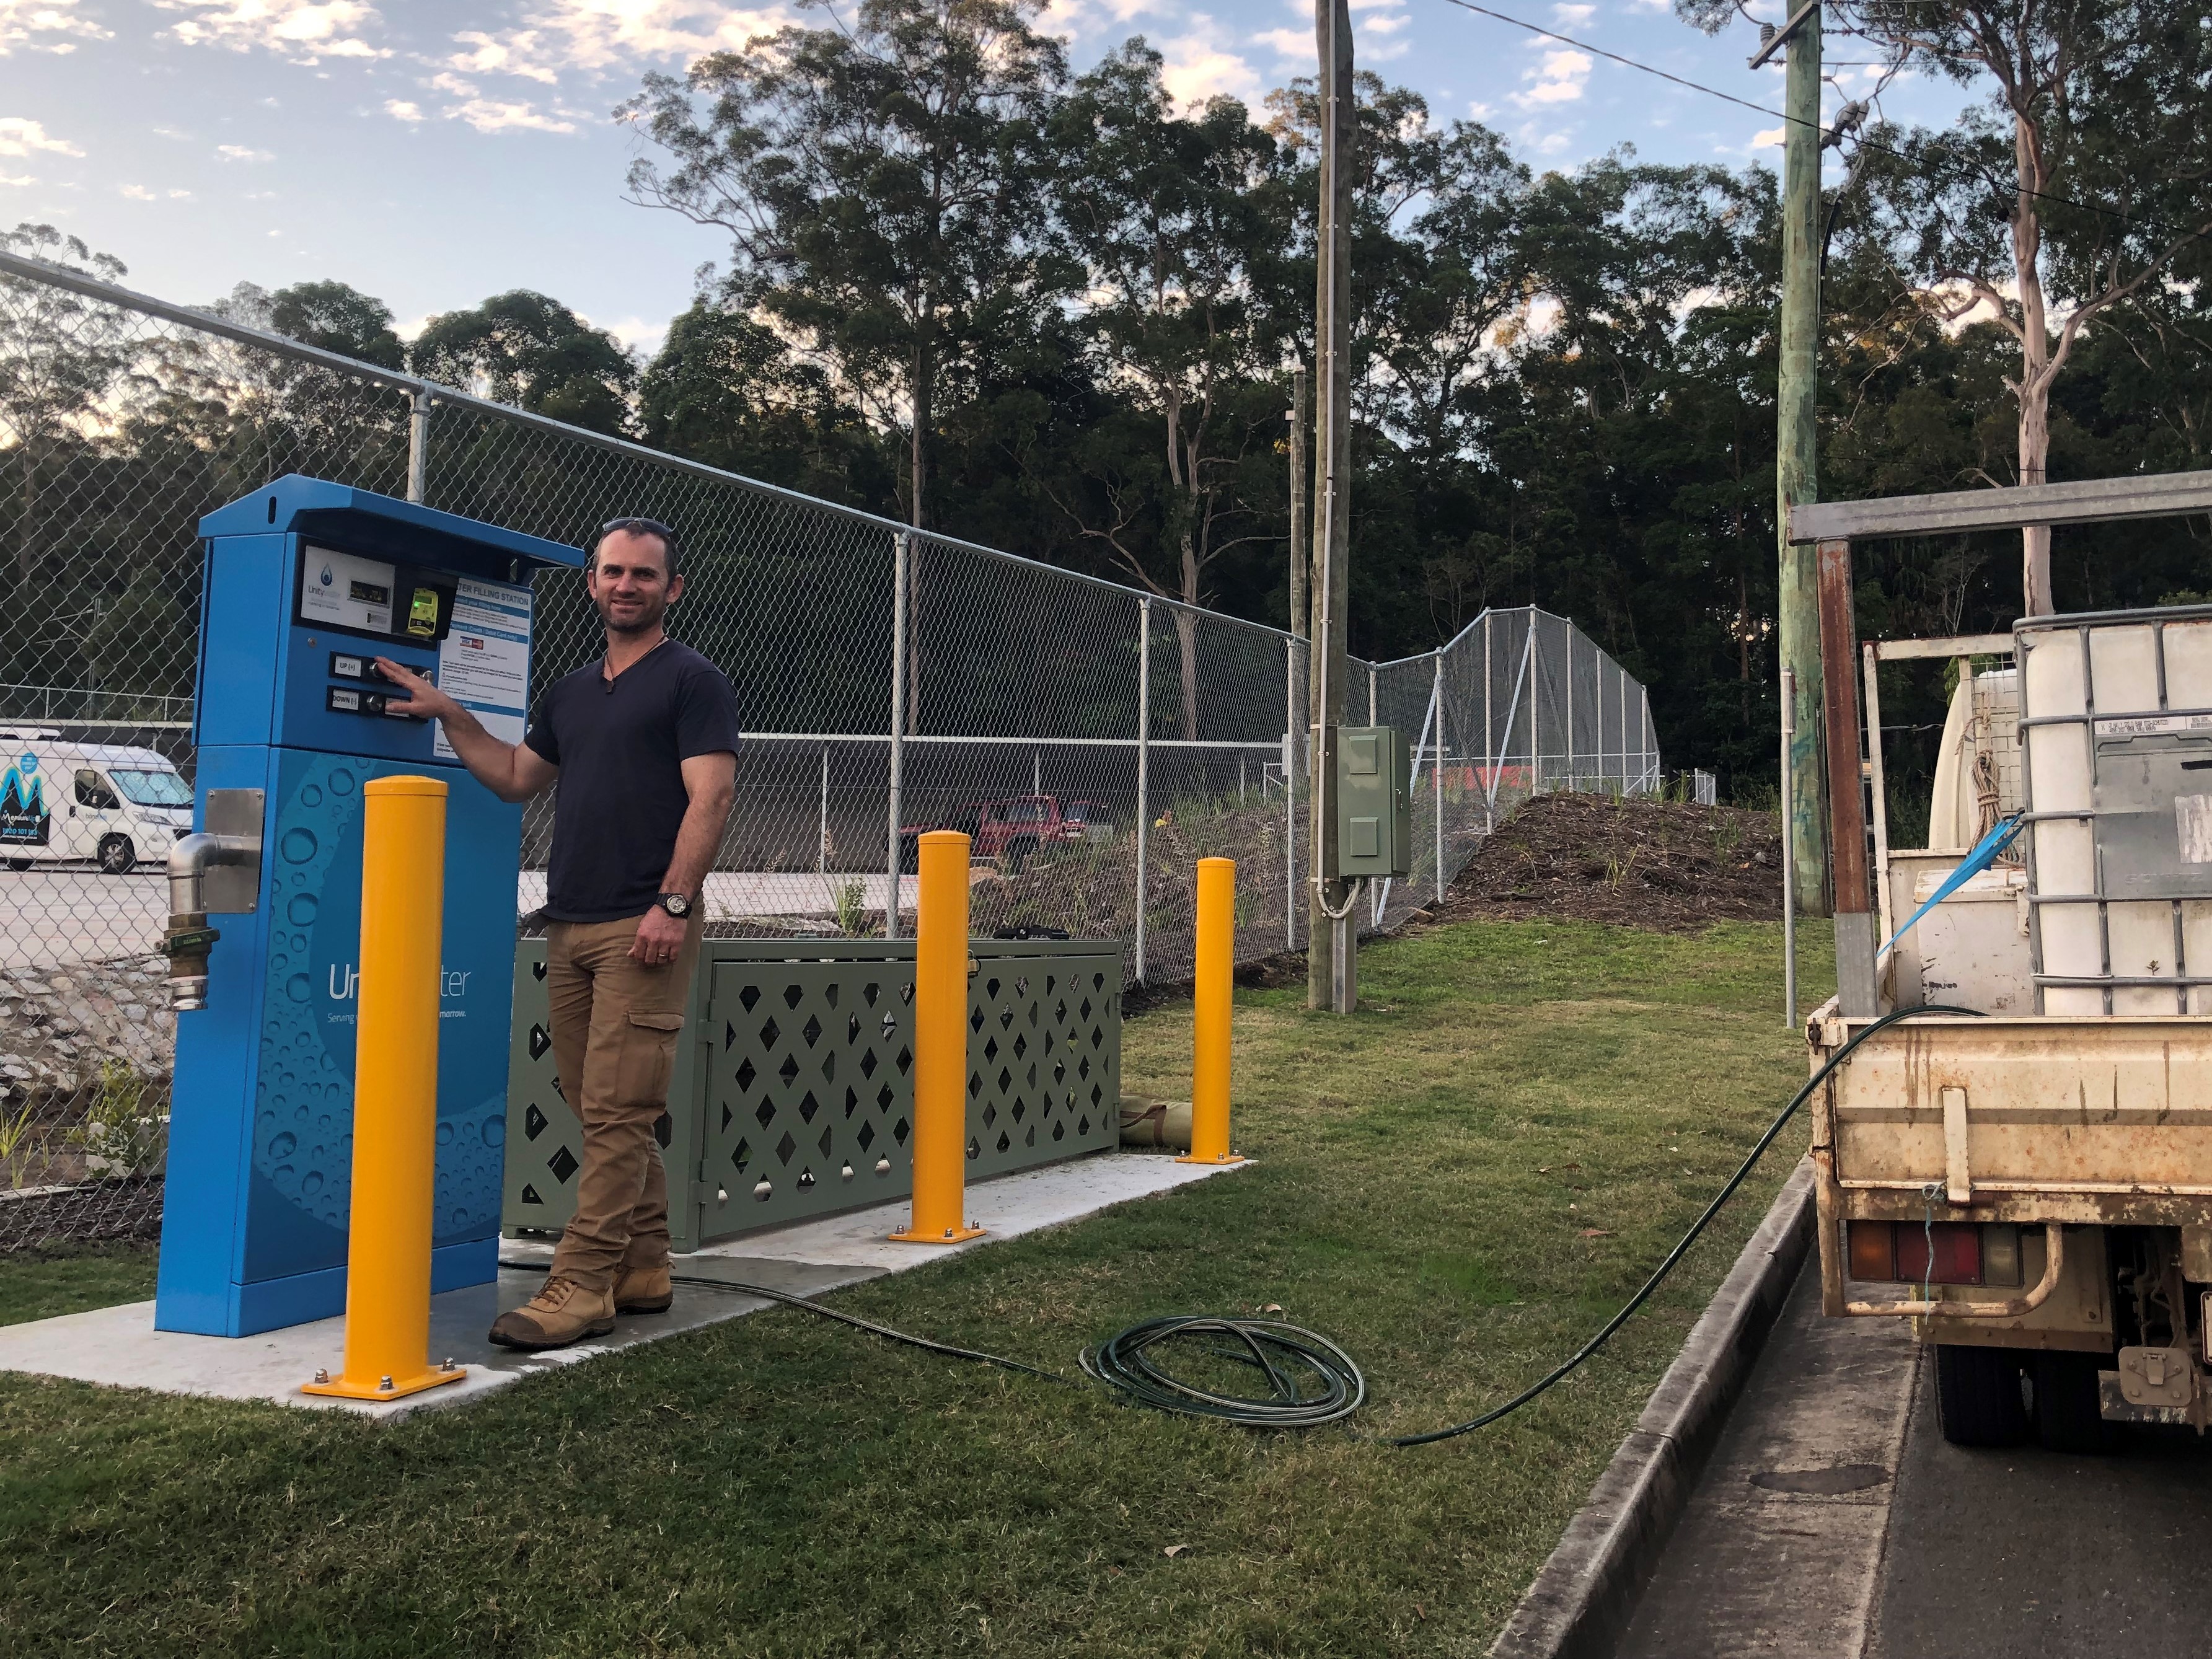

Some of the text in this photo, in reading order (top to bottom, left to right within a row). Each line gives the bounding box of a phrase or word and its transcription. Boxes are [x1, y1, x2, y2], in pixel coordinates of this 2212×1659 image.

[457, 583, 472, 592] TER
[474, 586, 500, 599] FILLING
[501, 593, 529, 605] STATION
[348, 663, 356, 671] (+)
[333, 695, 350, 704] DOWN
[327, 1013, 354, 1024] Serving
